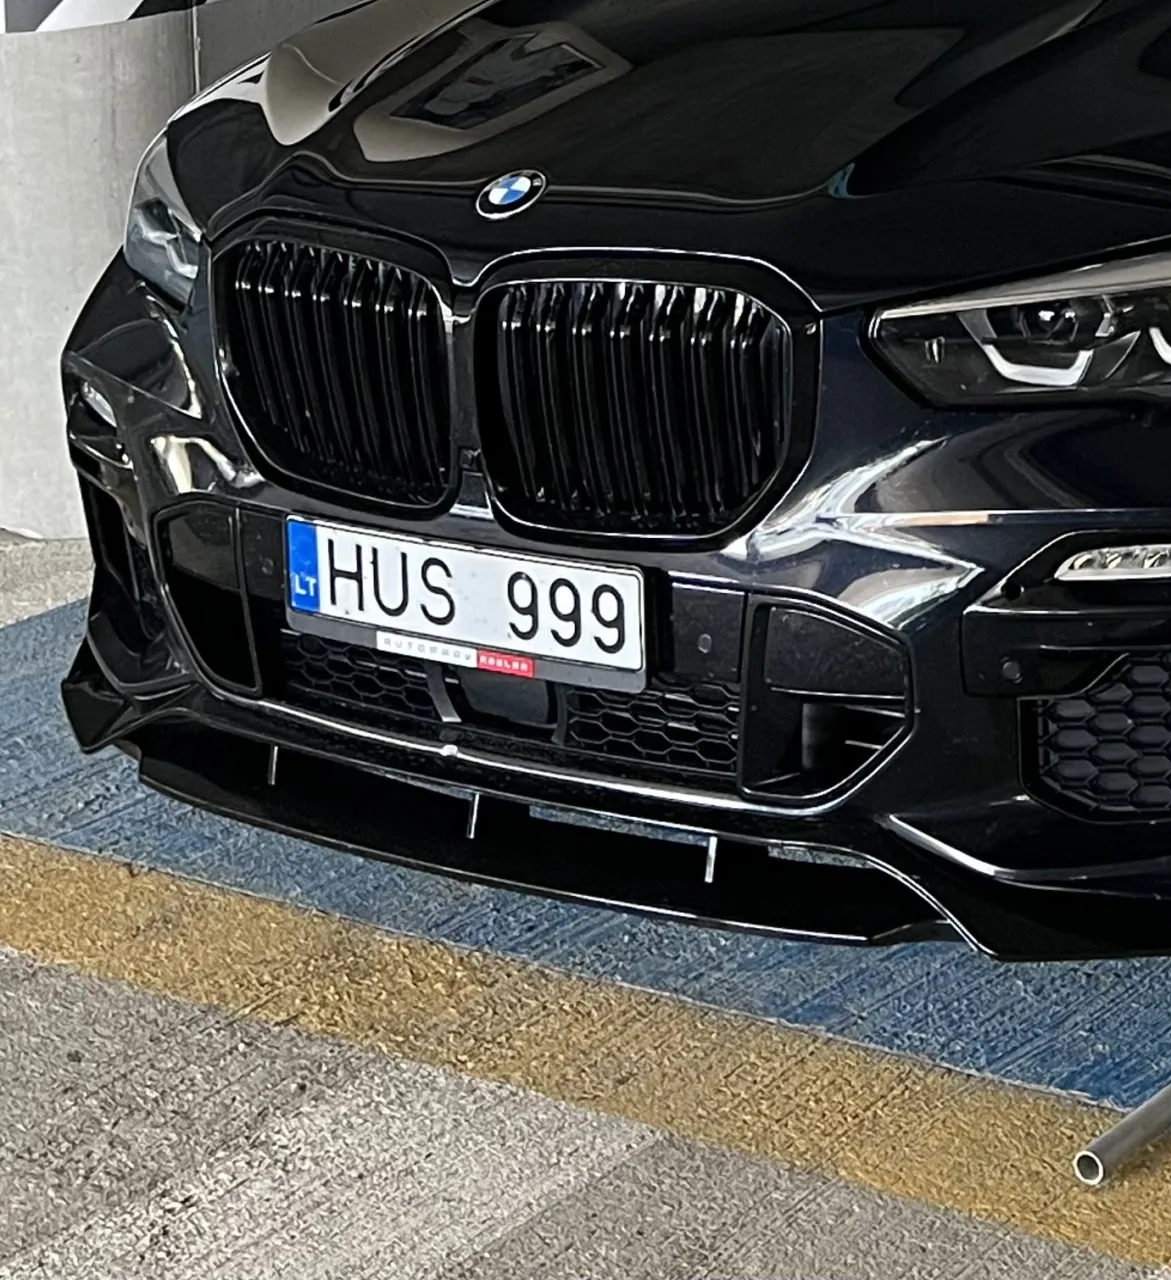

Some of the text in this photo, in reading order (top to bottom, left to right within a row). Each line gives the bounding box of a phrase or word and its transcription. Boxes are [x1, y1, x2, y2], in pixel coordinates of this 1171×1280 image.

[293, 572, 317, 597] LT
[327, 538, 626, 654] HUS 999
